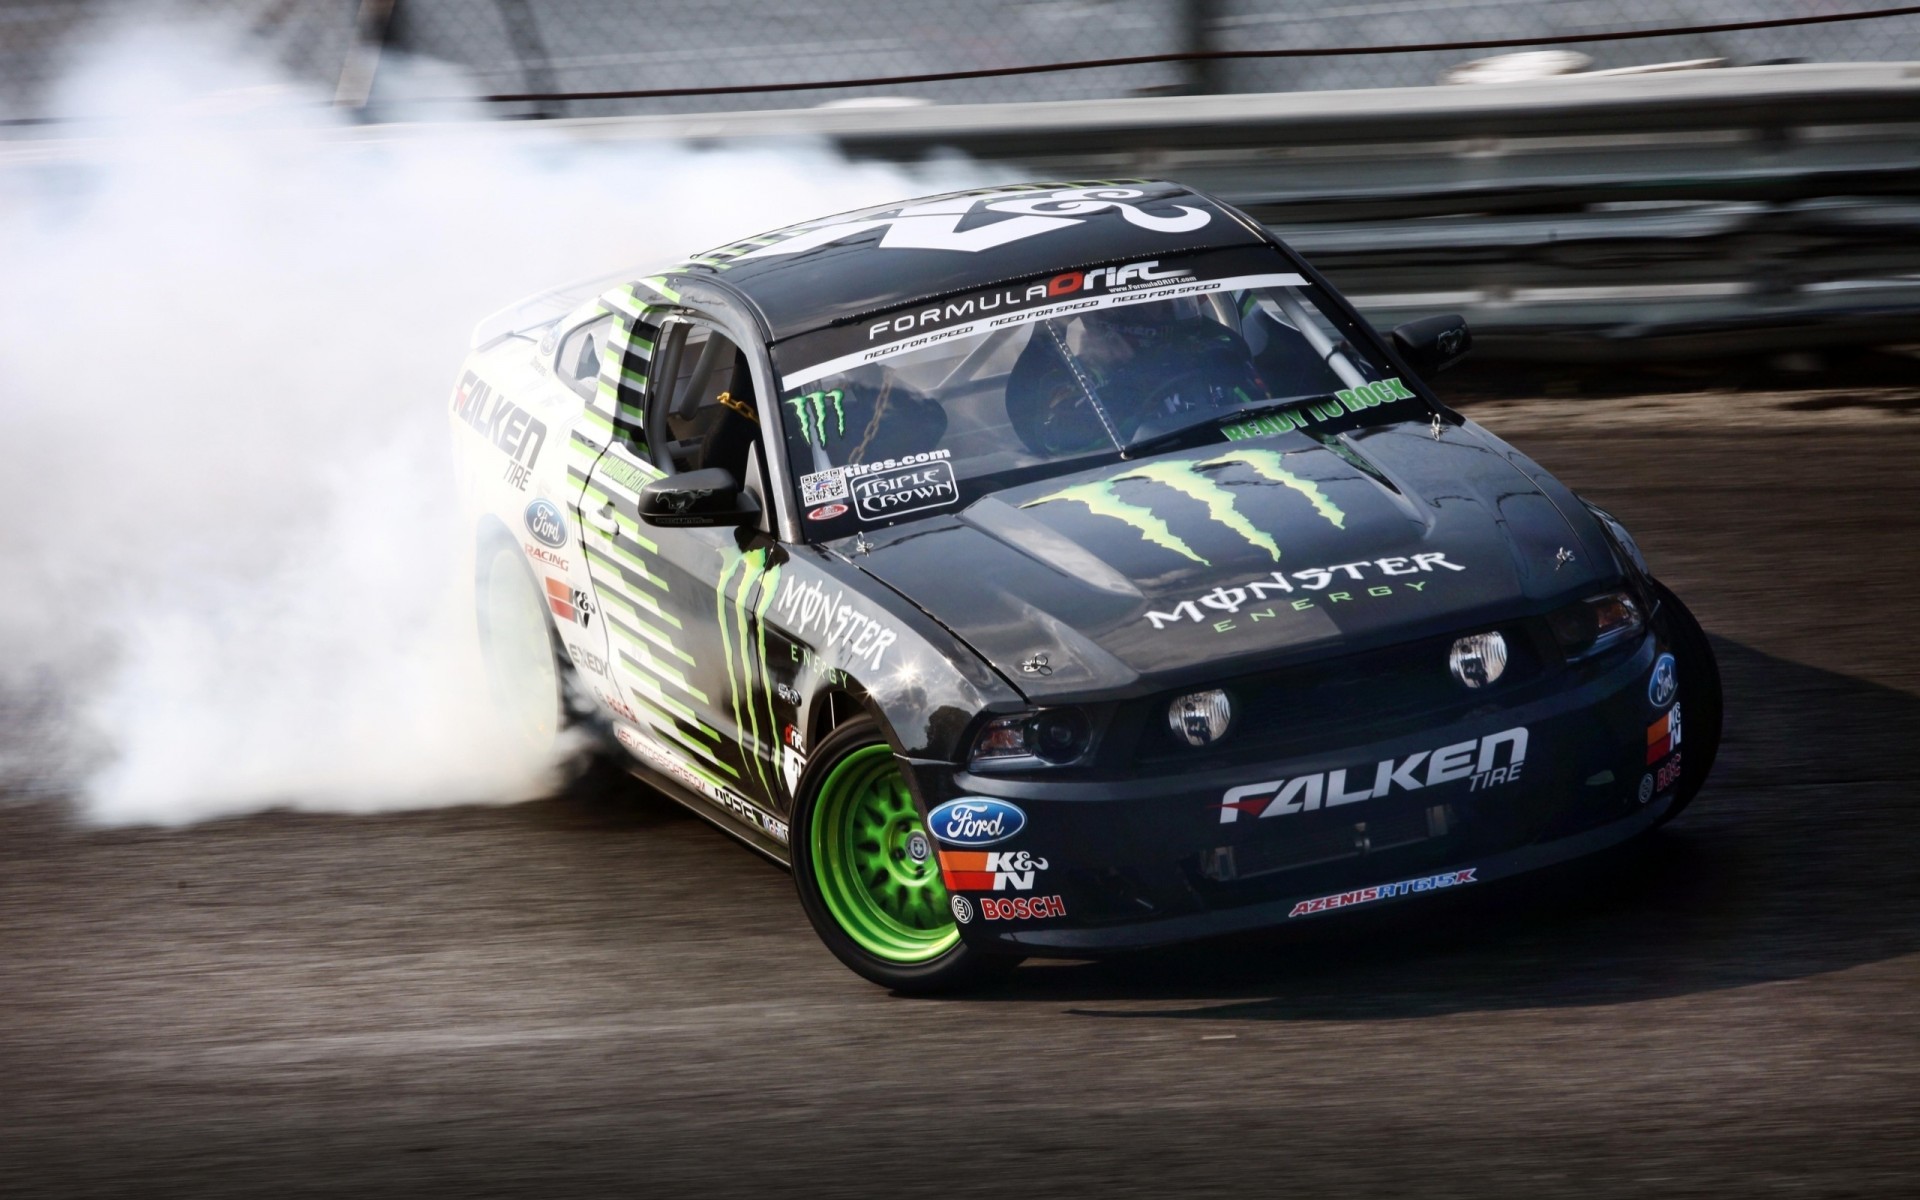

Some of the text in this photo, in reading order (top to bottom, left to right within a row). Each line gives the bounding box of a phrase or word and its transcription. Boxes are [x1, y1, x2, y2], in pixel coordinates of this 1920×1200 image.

[1112, 283, 1221, 304] NEED FOR SPEED
[869, 283, 1047, 341] FORMULA
[990, 300, 1099, 327] NEED FOR SPEED
[864, 326, 974, 360] NEED FOR SPEED
[453, 369, 547, 470] FALKEN
[1221, 377, 1417, 441] READY TO ROCK
[503, 459, 532, 492] TIRE
[844, 449, 951, 477] tires.com
[856, 469, 940, 497] TRIPLE
[862, 481, 952, 511] CROWN
[533, 504, 560, 542] Ford
[524, 543, 569, 572] RACING
[1213, 581, 1426, 633] ENERGY
[569, 642, 610, 680] EXEDY
[791, 642, 848, 688] ENERGY
[1656, 662, 1674, 702] Ford
[1218, 726, 1529, 824] FALKEN
[1469, 761, 1525, 792] TIRE
[946, 804, 1005, 838] Ford
[980, 895, 1067, 921] BOSCH
